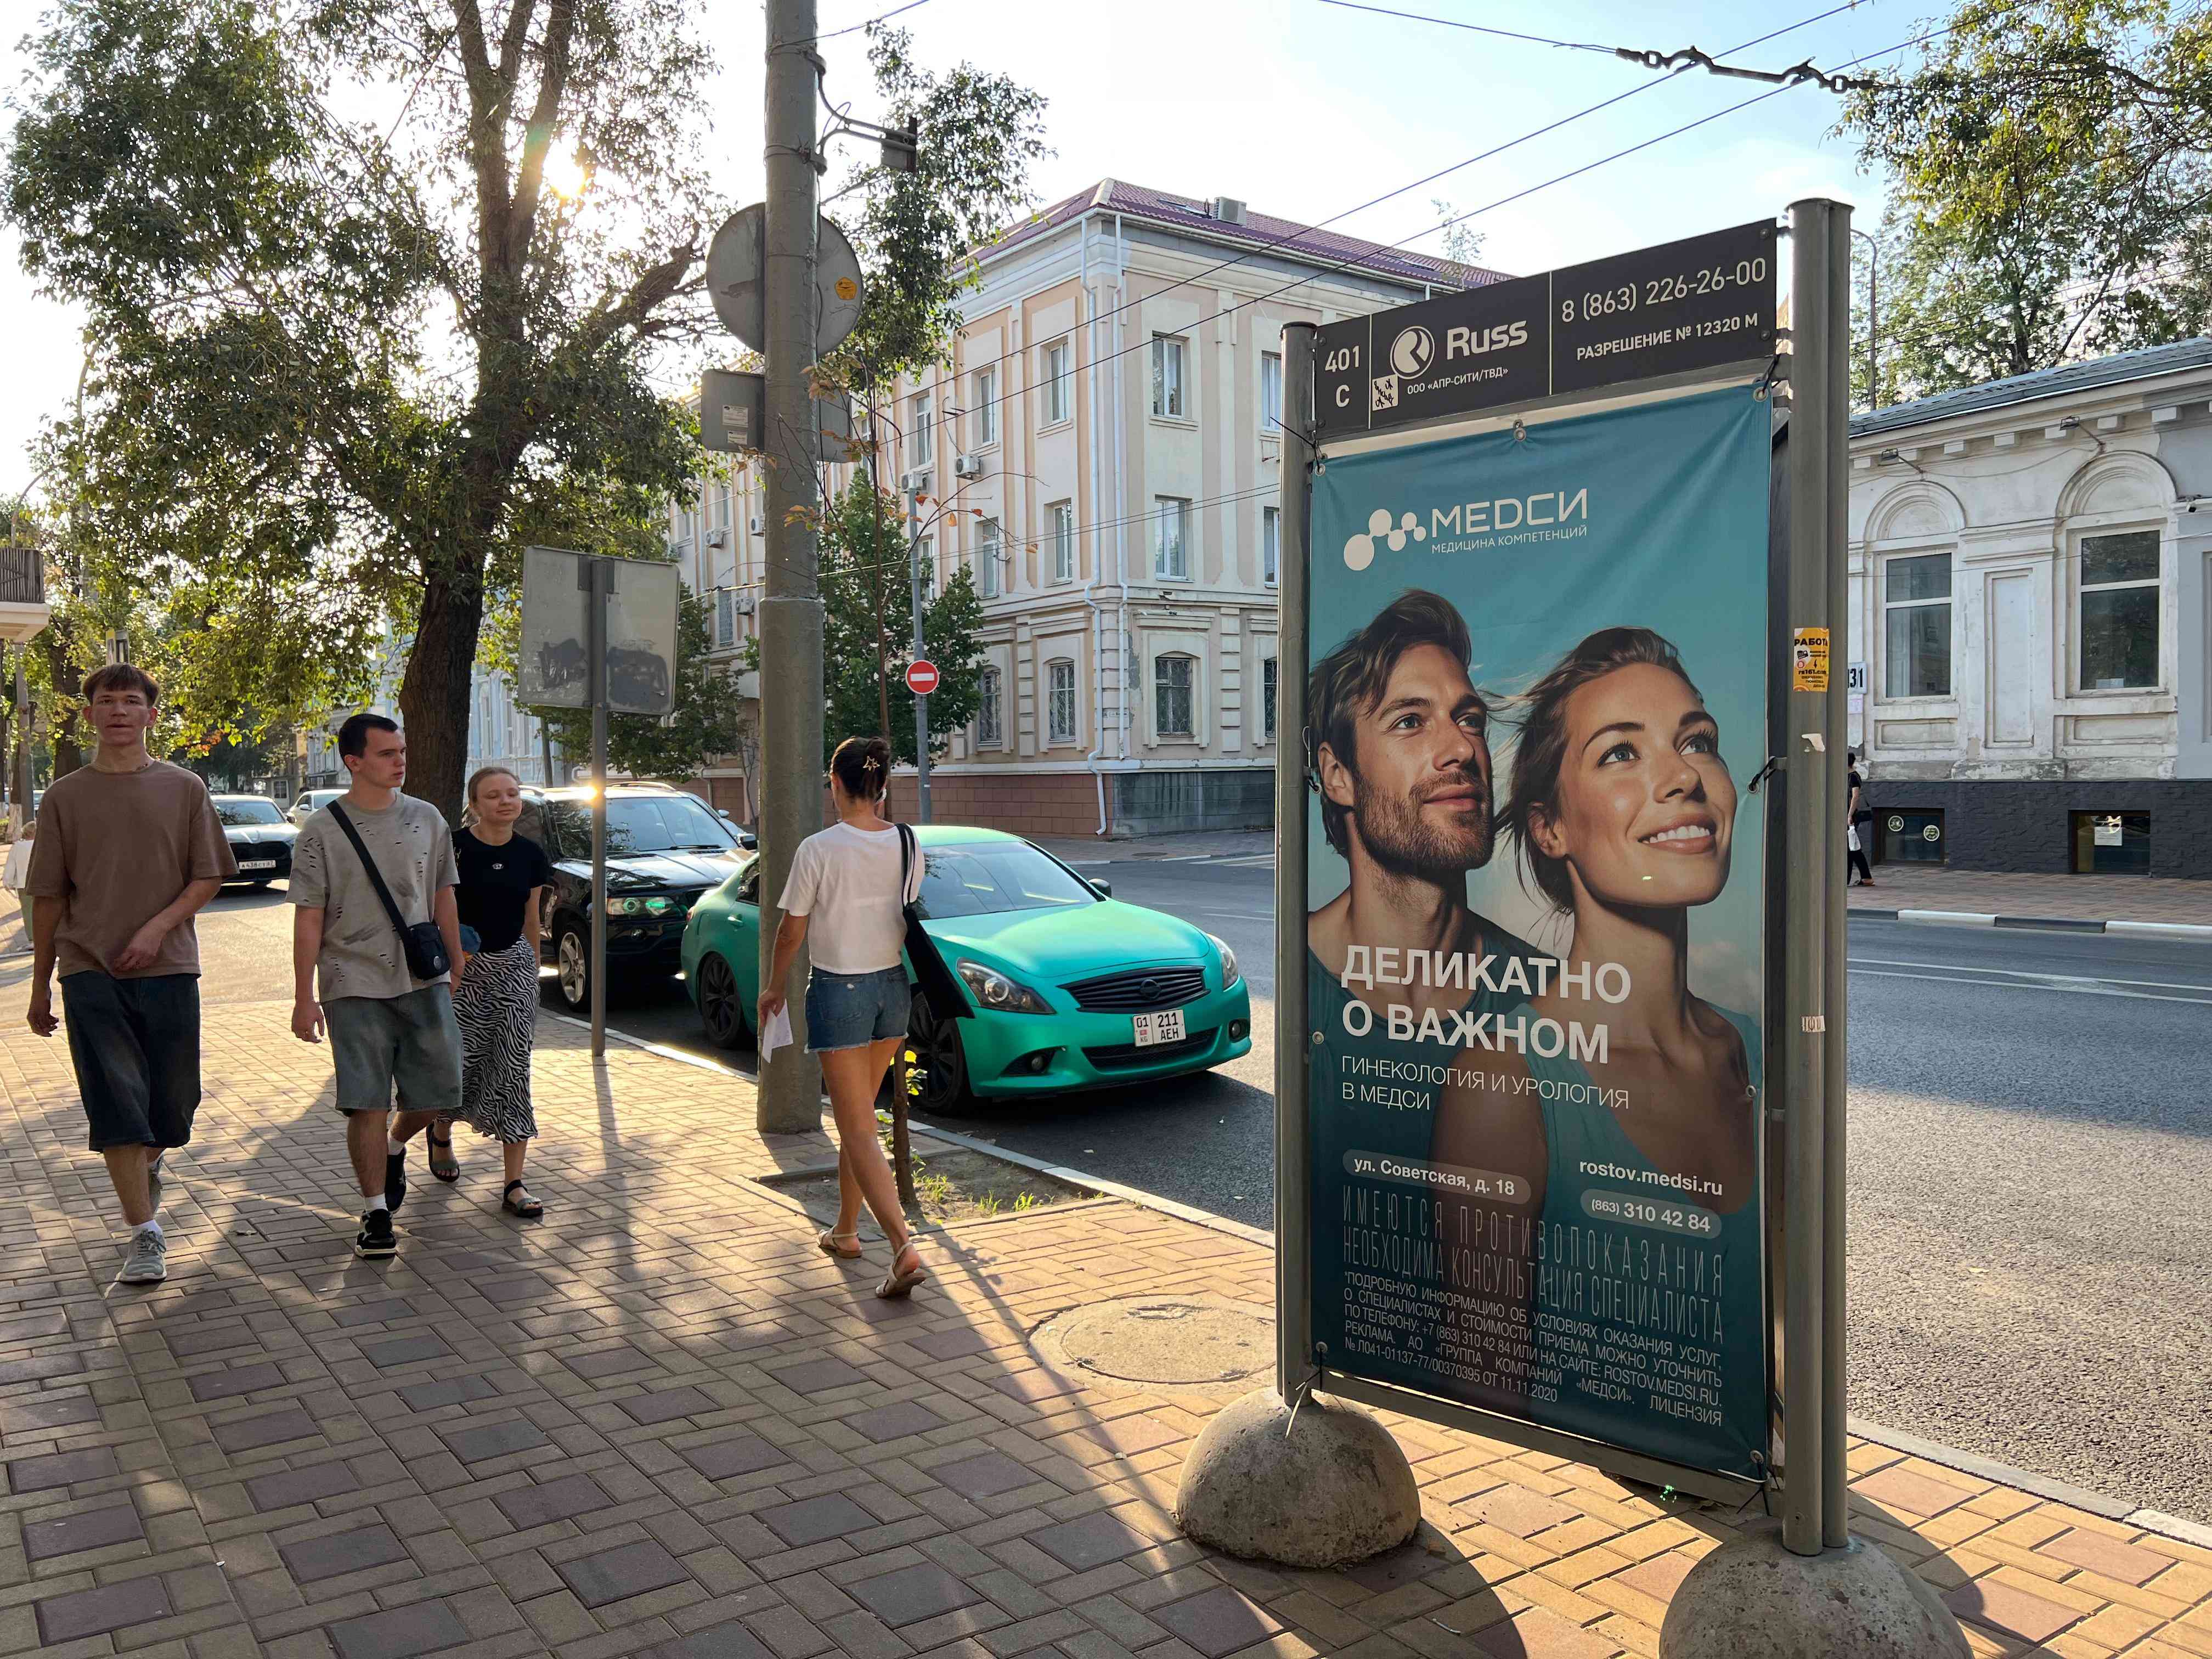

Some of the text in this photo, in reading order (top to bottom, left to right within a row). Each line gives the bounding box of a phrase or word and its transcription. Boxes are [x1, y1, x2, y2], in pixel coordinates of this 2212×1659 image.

[1562, 258, 1766, 323] 8 (863) 226-26-00
[1325, 346, 1360, 373] 401
[1447, 320, 1528, 360] Russ
[1577, 313, 1758, 360] РАЗРЕШЕНИЕ № 12320 М
[1336, 385, 1350, 408] С
[1407, 383, 1425, 395] ООО
[1427, 366, 1509, 391] «АПР-СИТИ/ТВД»
[1432, 524, 1587, 554] МЕДИЦИНА КОМПЕТЕНЦИЙ
[1341, 944, 1632, 1004] ДЕЛИКАТНО
[1137, 1012, 1178, 1028] 01 211
[1161, 1028, 1178, 1041] AEH
[1342, 1000, 1609, 1064] О ВАЖНОМ
[1341, 1056, 1629, 1109] ГИНЕКОЛОГИЯ И УРОЛОГИЯ
[1342, 1082, 1430, 1111] В МЕДСИ
[1354, 1158, 1515, 1195] ул. Советская, д. 18
[1579, 1161, 1723, 1196] rostov.medsi.ru
[1592, 1199, 1711, 1232] (863) 310 42 84
[1344, 1185, 1722, 1297] ИМЕЮТСЯ ПРОТИВОПОКАЗАНИЯ
[1344, 1225, 1723, 1344] НЕОБХОДИМА КОНСУЛЬТАЦИЯ СПЕЦИАЛИСТА
[1344, 1288, 1722, 1387] О СПЕЦИАЛИСТАХ И СТОИМОСТИ ПРИЕМА МОЖНО УТОЧНИТЬ
[1422, 1288, 1504, 1317] ИНФОРМАЦИЮ
[1510, 1307, 1527, 1322] ОБ
[1533, 1312, 1598, 1339] УСЛОВИЯХ
[1604, 1328, 1673, 1357] ОКАЗАНИЯ
[1679, 1345, 1721, 1370] УСЛУГ,
[1345, 1304, 1722, 1407] ПО ТЕЛЕФОНУ: +7 (863) 310 42 84 ИЛИ НА САЙТЕ: ROSTOV.MEDSI.RU.
[1345, 1337, 1557, 1402] № Л041-01137-77/00370395 ОТ 11.11.2020
[1346, 1321, 1722, 1426] РЕКЛАМА. АО «ГРУППА КОМПАНИЙ «МЕДСИ». ЛИЦЕНЗИЯ
